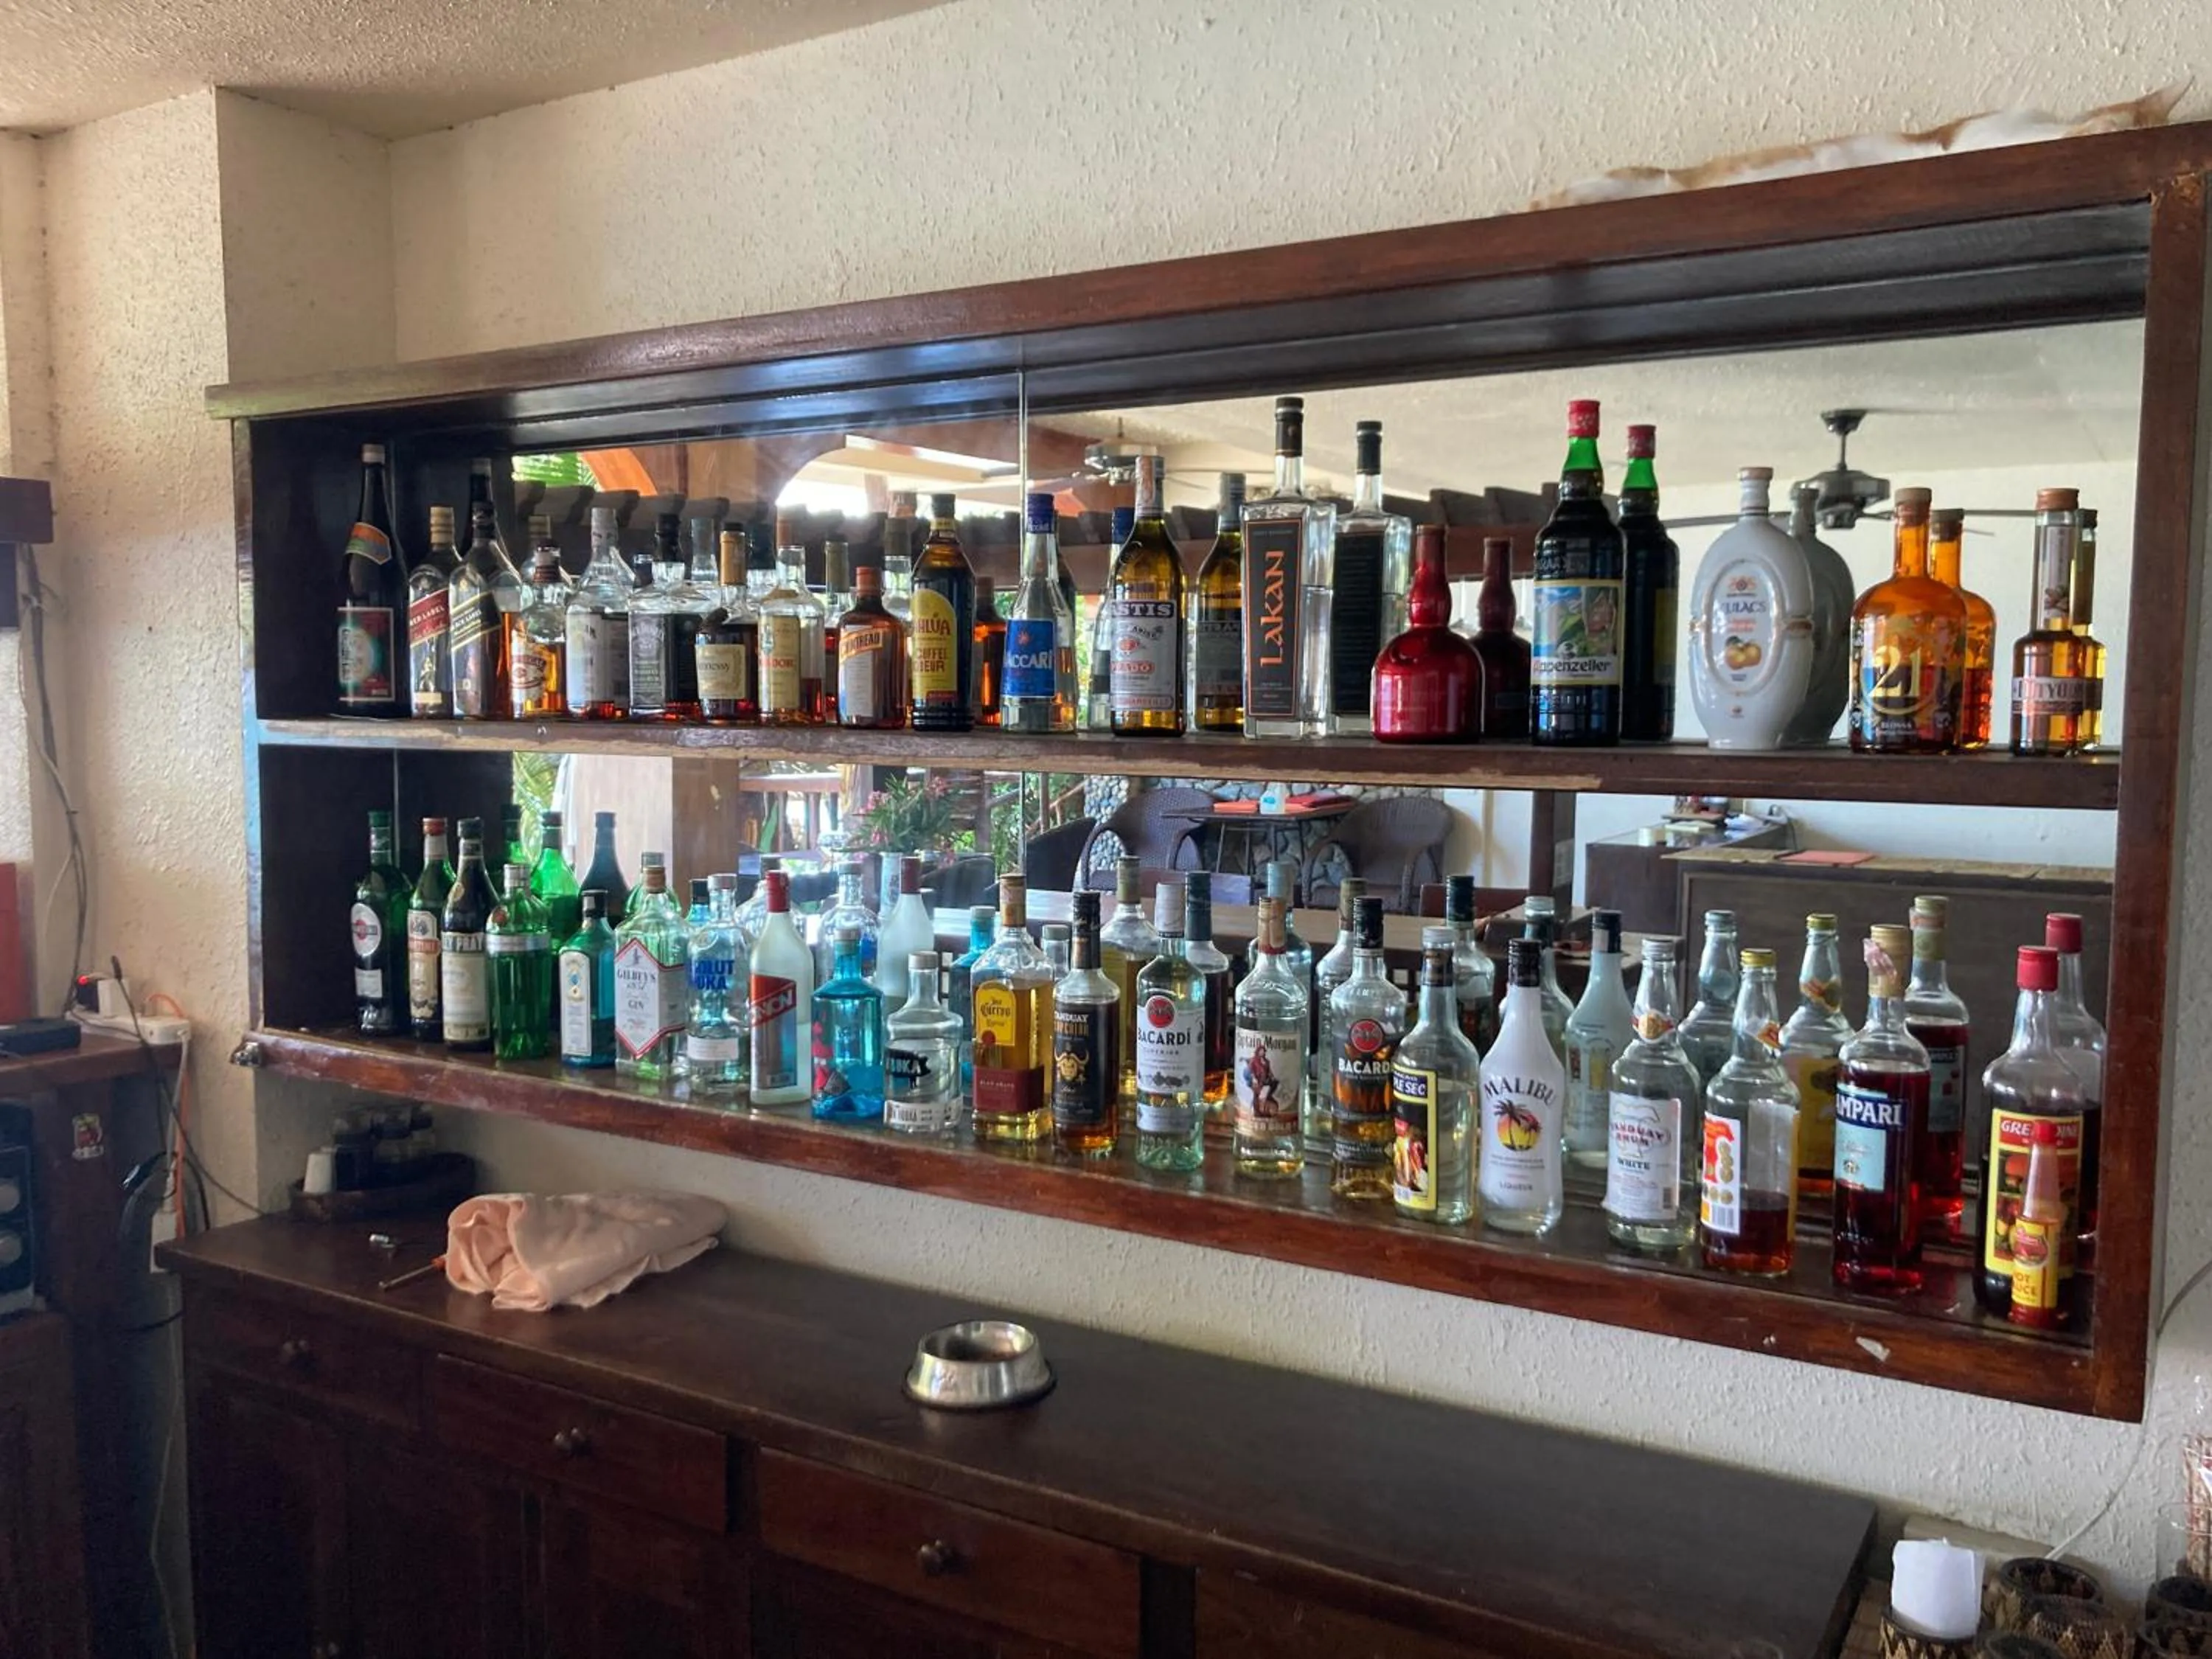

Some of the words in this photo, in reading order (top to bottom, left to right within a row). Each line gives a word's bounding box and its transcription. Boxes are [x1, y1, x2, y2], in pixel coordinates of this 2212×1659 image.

[1113, 603, 1171, 616] ASTIS
[1260, 550, 1284, 667] LAKAN
[1869, 646, 1921, 697] 21
[628, 1000, 644, 1009] GIN
[1338, 1057, 1391, 1074] BACARD
[1405, 1080, 1426, 1096] SEC
[1484, 1077, 1557, 1107] MALIBU
[1836, 1093, 1903, 1126] AMPARI
[1617, 1156, 1651, 1170] WHITE
